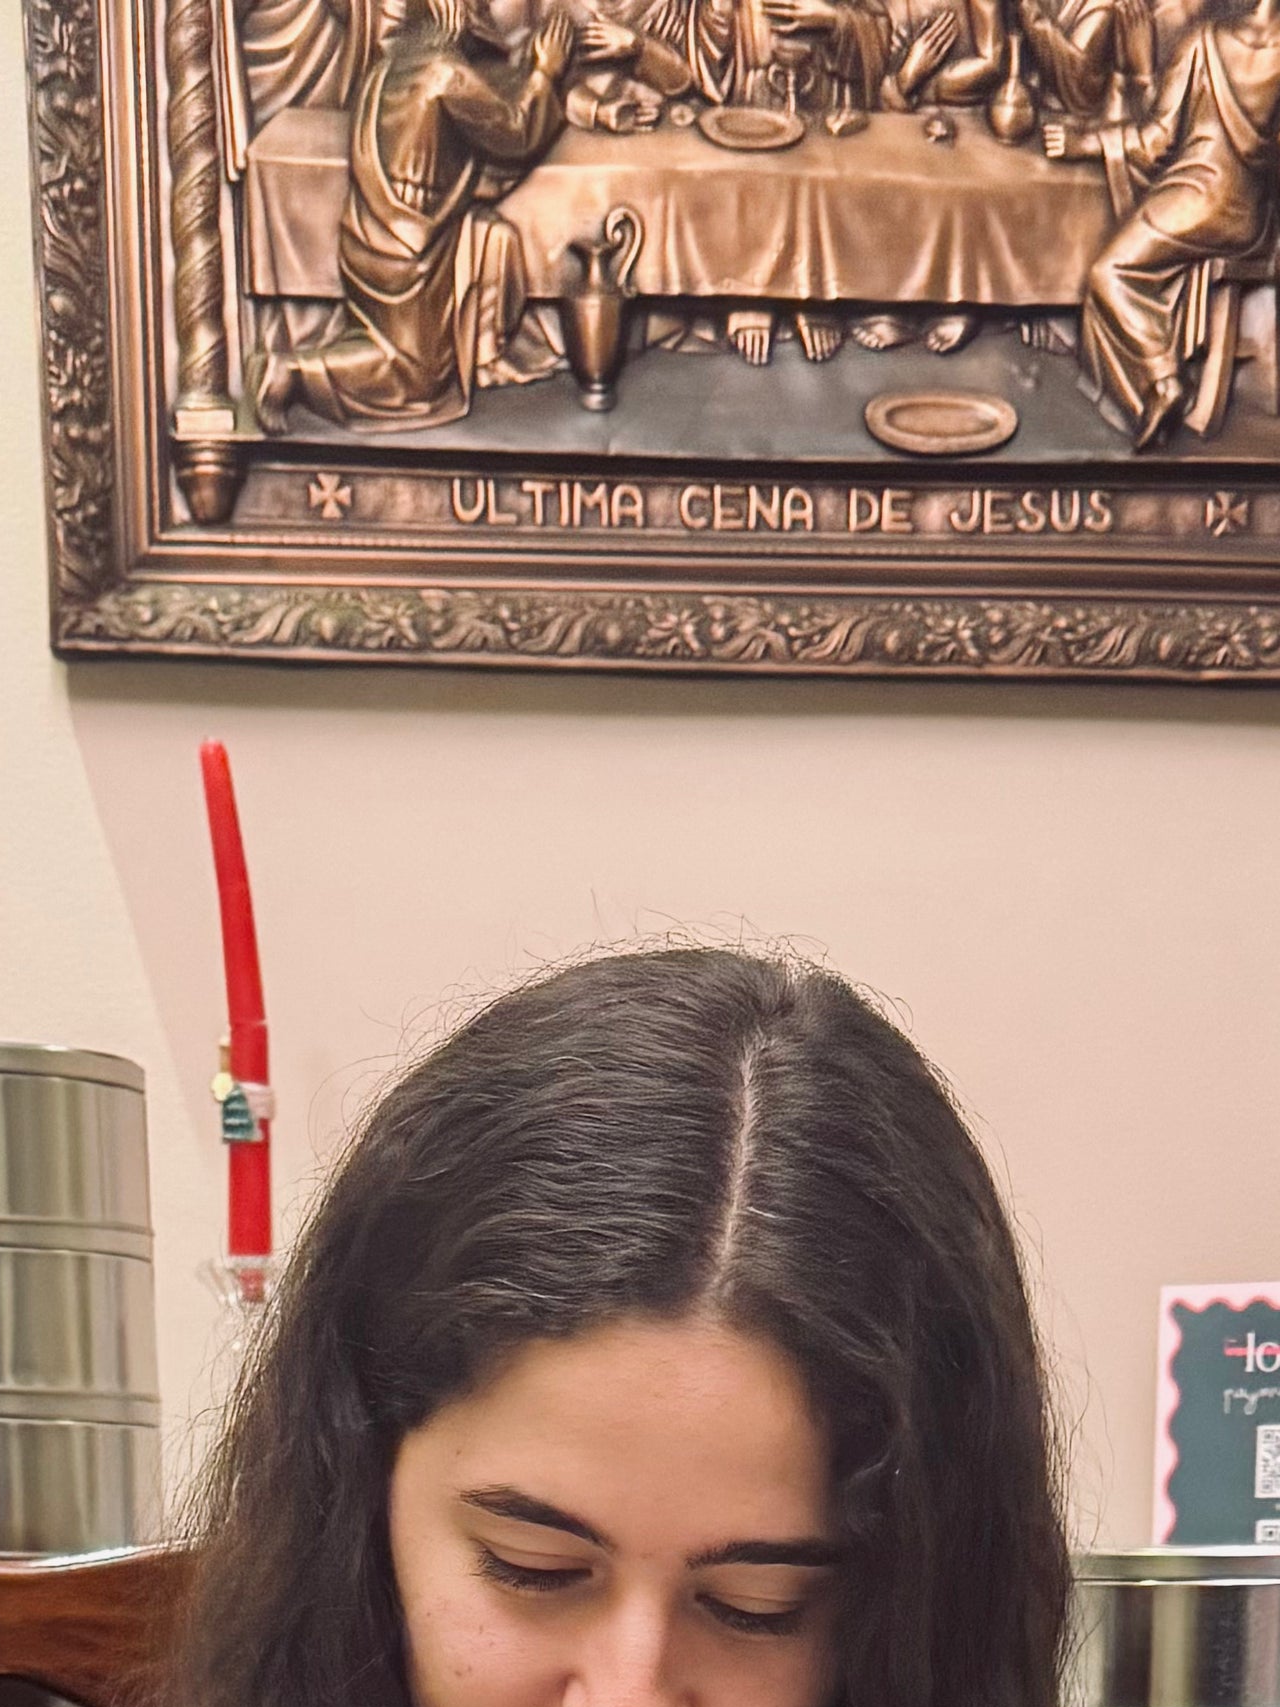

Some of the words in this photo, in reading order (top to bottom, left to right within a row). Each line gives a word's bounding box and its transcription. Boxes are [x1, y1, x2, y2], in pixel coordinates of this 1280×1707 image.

[453, 478, 643, 528] ULTIMA
[680, 484, 813, 531] CENA
[848, 488, 912, 533] DE
[950, 488, 1112, 535] JESUS
